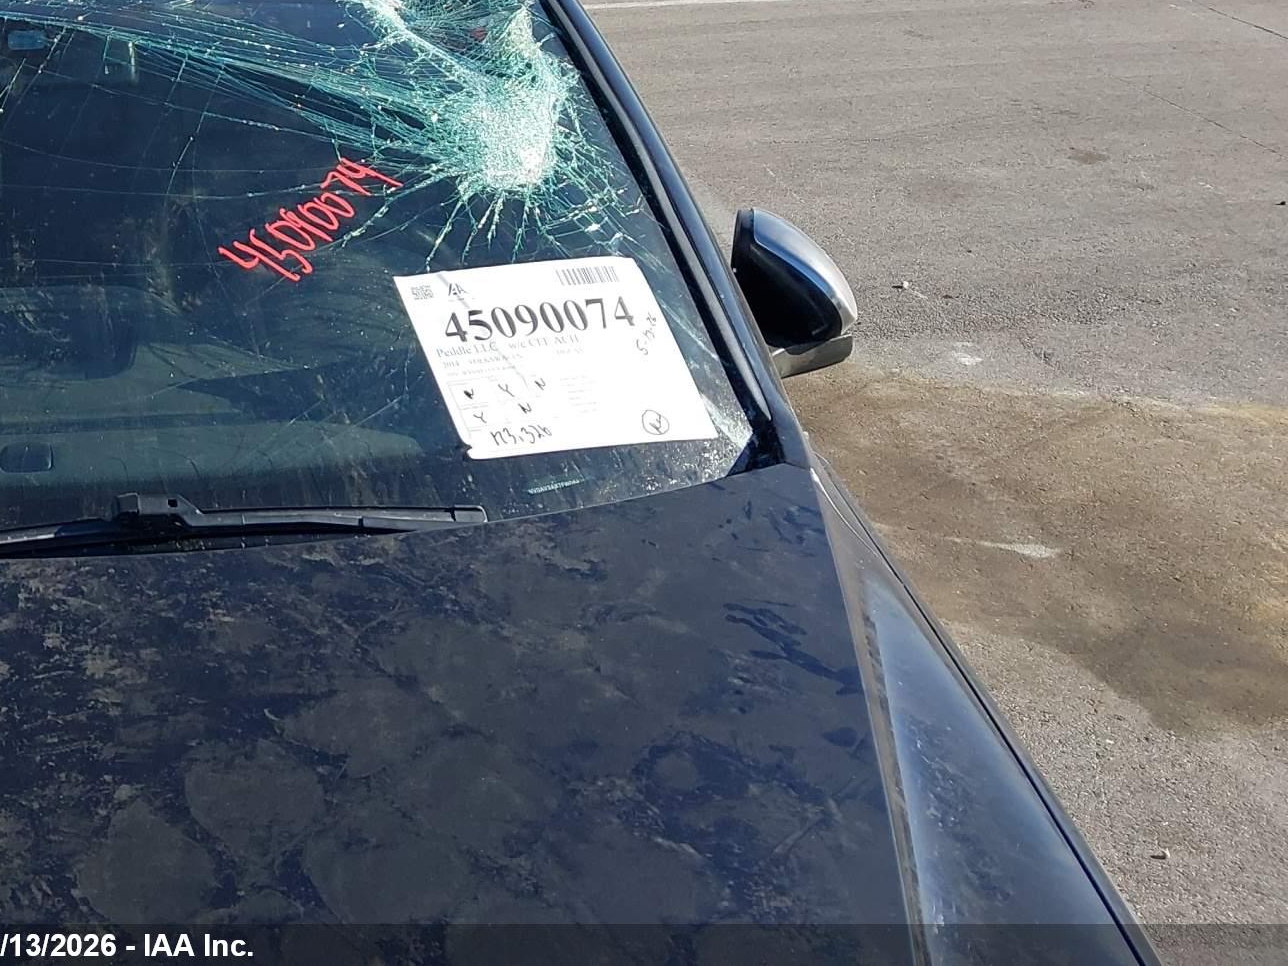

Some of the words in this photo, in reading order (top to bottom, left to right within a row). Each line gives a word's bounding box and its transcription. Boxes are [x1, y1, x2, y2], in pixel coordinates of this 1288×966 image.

[218, 157, 404, 281] 45090074
[445, 296, 635, 342] 45090074
[436, 345, 472, 358] Peddle
[473, 341, 498, 354] LLC
